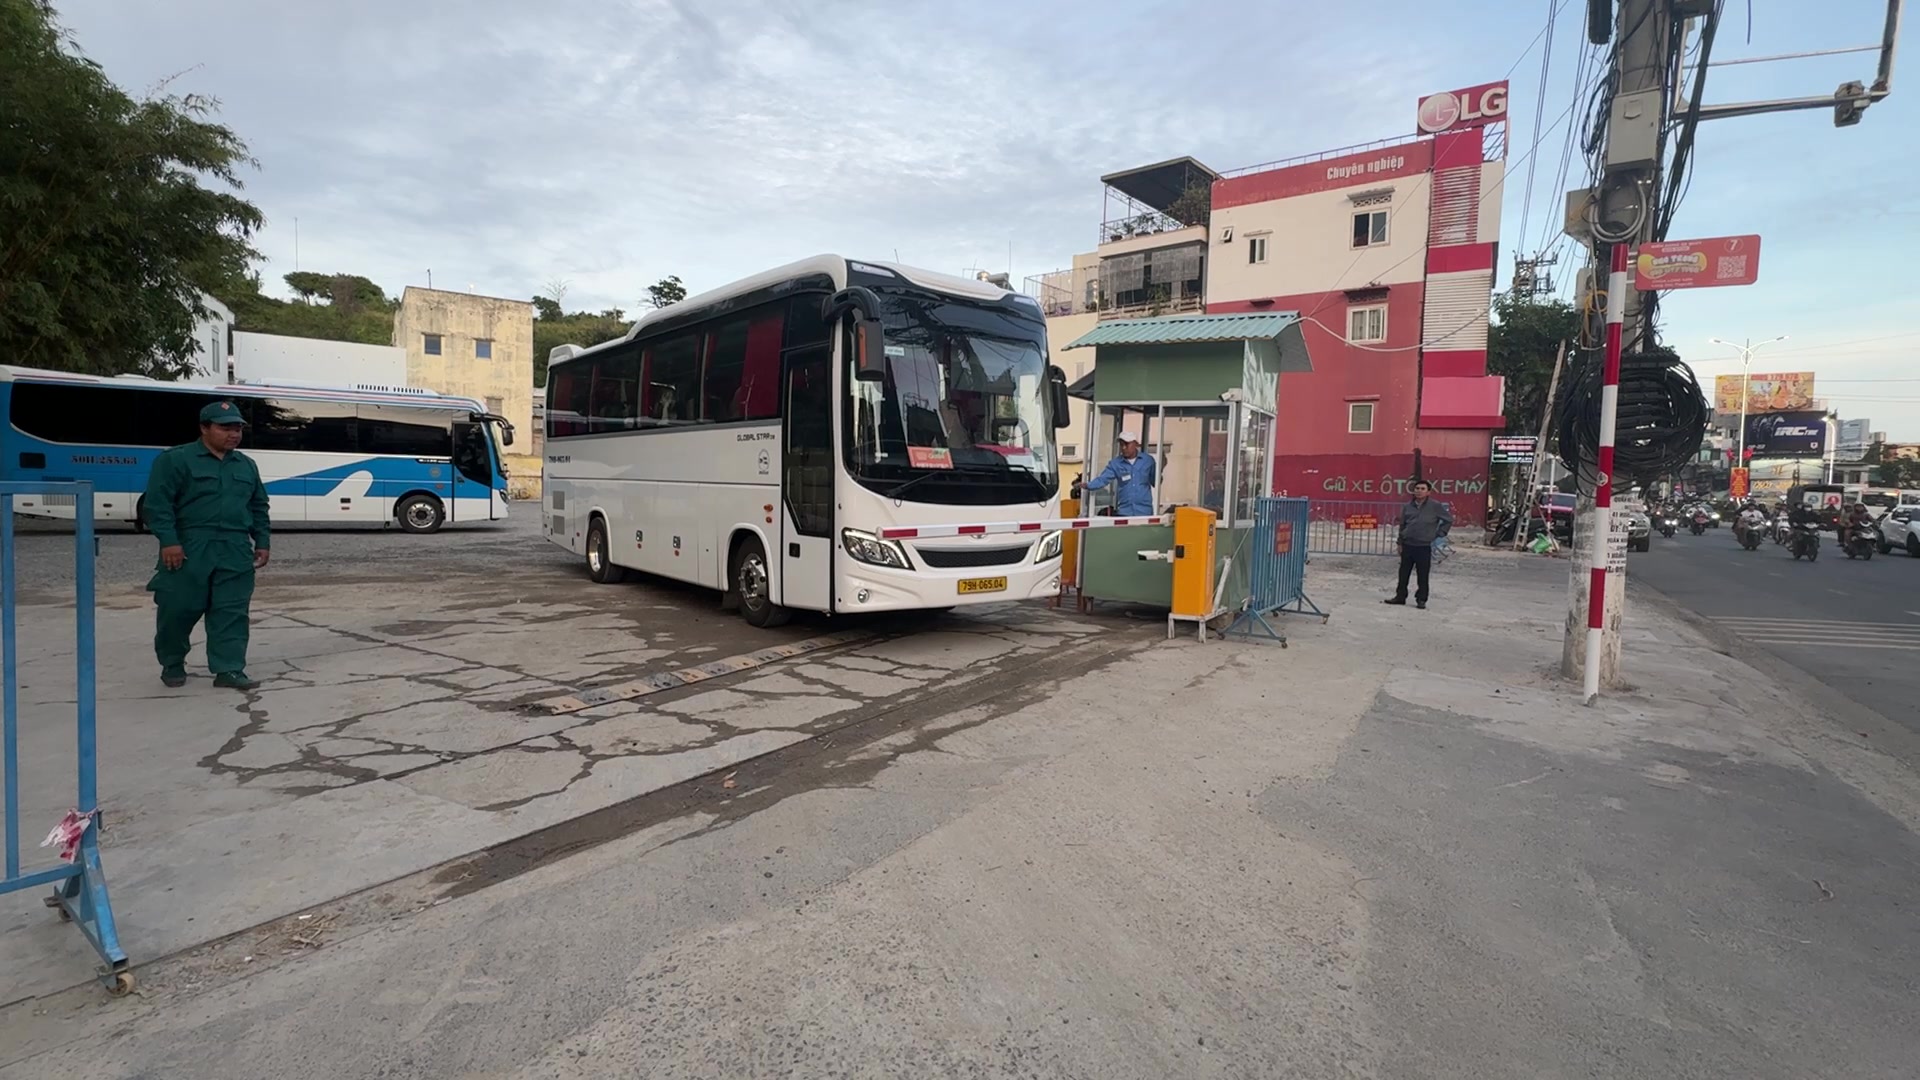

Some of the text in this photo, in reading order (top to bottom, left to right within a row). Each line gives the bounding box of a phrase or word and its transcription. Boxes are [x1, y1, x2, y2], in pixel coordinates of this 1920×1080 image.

[1459, 86, 1507, 121] LG
[1327, 155, 1405, 180] Chuyên nghiệp
[1730, 239, 1738, 251] 7
